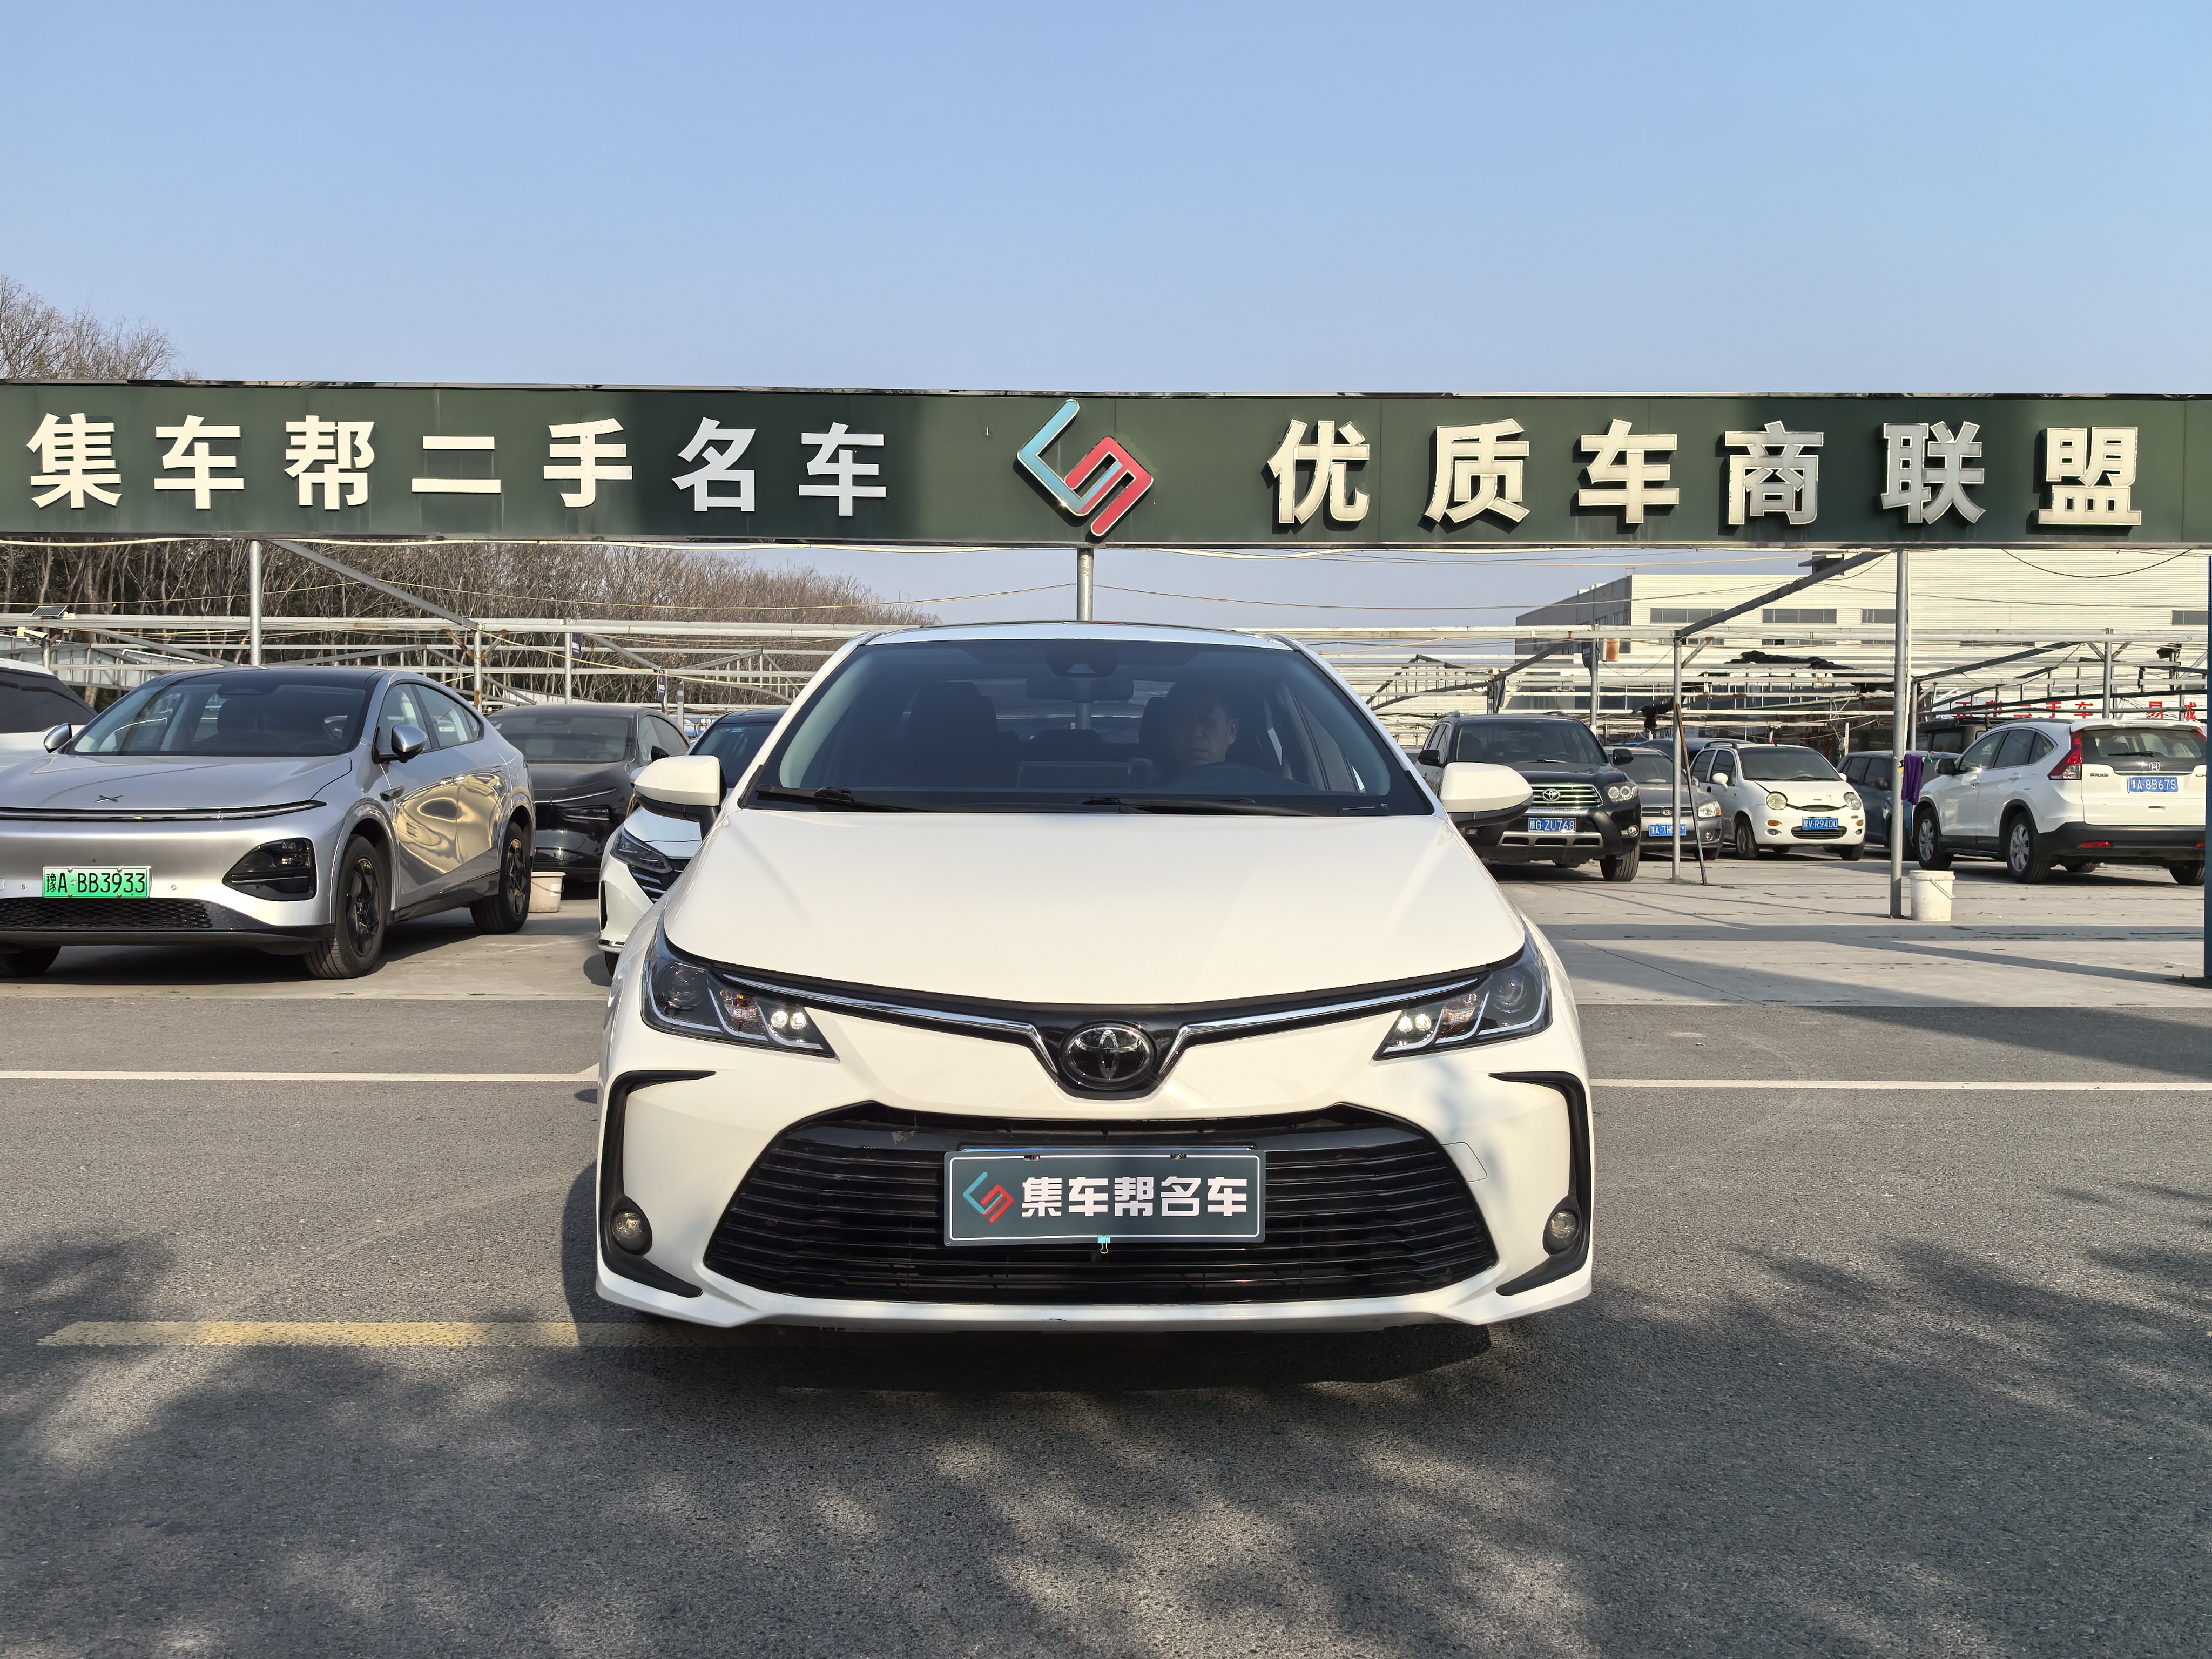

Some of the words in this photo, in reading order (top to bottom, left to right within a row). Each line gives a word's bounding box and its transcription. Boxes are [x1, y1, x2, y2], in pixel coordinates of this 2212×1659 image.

[26, 412, 886, 516] 集车帮二手名车
[1267, 418, 2142, 525] 优质车商联盟
[1022, 1176, 1247, 1217] 集车帮名车
